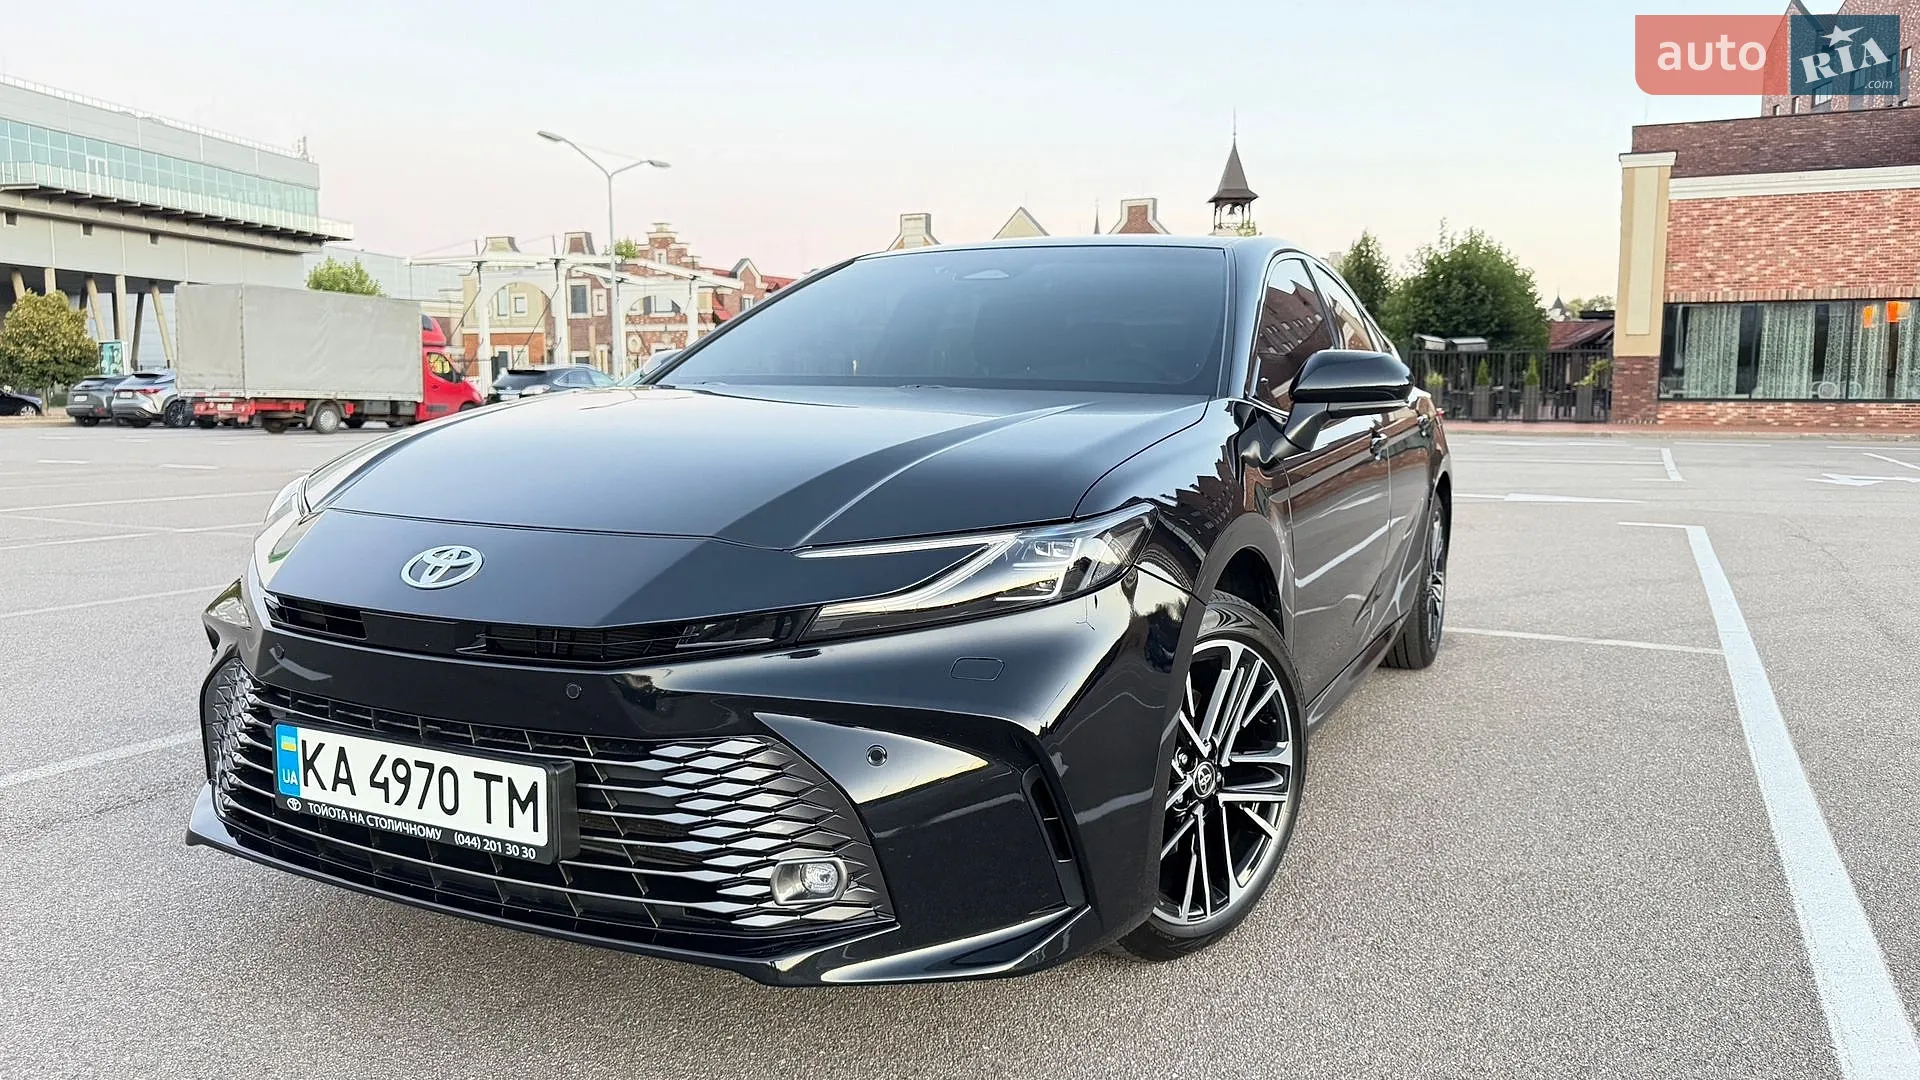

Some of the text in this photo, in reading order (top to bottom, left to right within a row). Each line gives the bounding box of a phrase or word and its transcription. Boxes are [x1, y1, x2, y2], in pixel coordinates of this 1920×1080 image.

[282, 768, 299, 786] UA
[301, 739, 539, 833] KA 4970 TM
[308, 802, 442, 840] ТОЙОТА НА СТОЛИЧНОМУ
[454, 832, 536, 860] (044) 201 30 30
